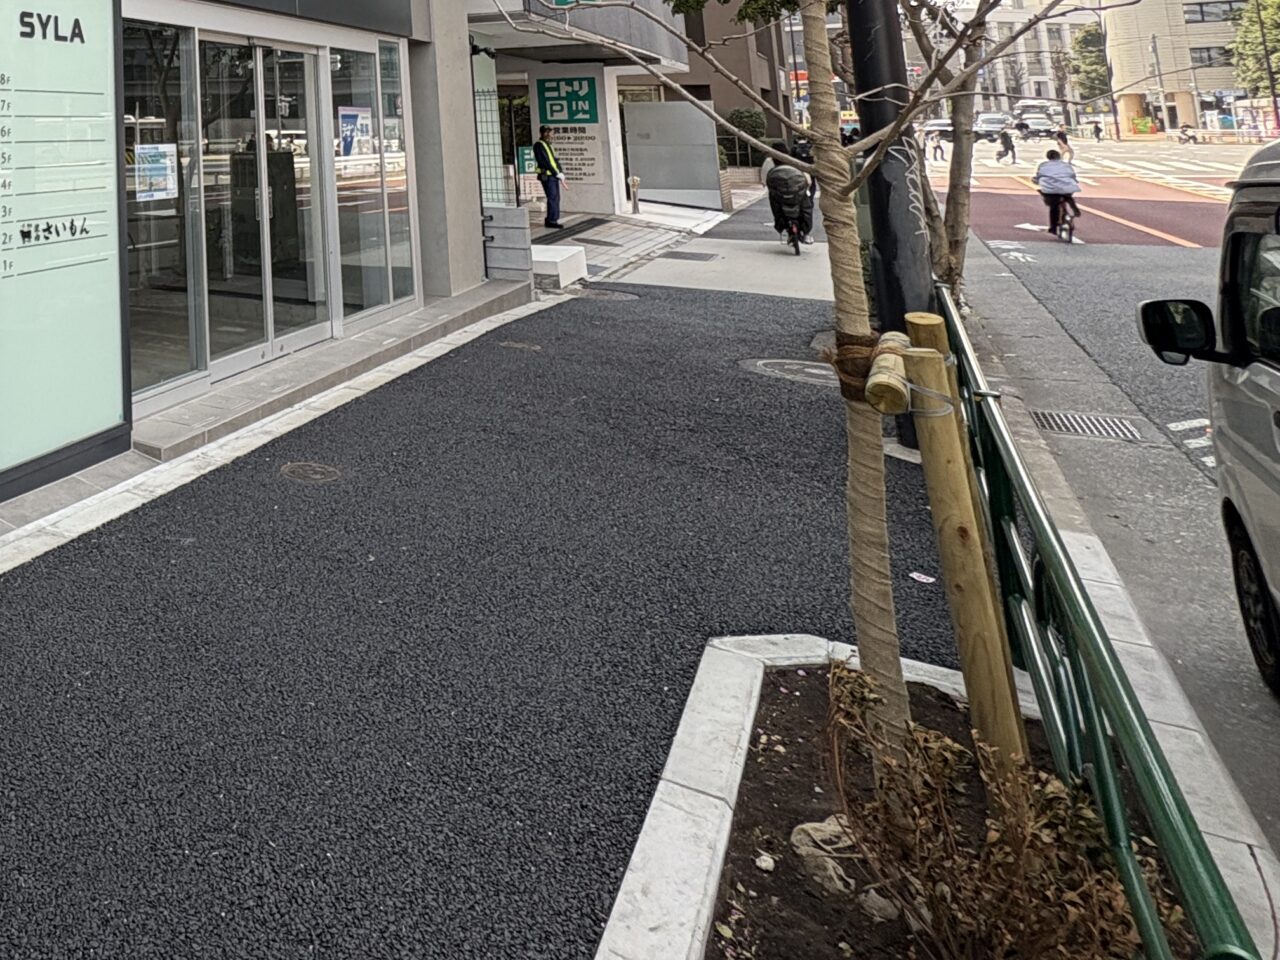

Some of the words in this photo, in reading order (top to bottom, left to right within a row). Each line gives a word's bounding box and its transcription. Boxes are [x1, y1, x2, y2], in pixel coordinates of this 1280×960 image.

[19, 11, 85, 44] SYLA
[0, 73, 11, 85] 8F
[544, 80, 589, 97] ニトリ
[0, 100, 11, 111] 7F
[572, 101, 589, 110] IN
[0, 126, 12, 137] 6F
[1, 152, 12, 164] 5F
[1, 179, 12, 190] 4F
[1, 205, 12, 217] 3F
[2, 232, 13, 245] 2F
[42, 217, 90, 240] さいもん
[3, 260, 14, 271] 1F
